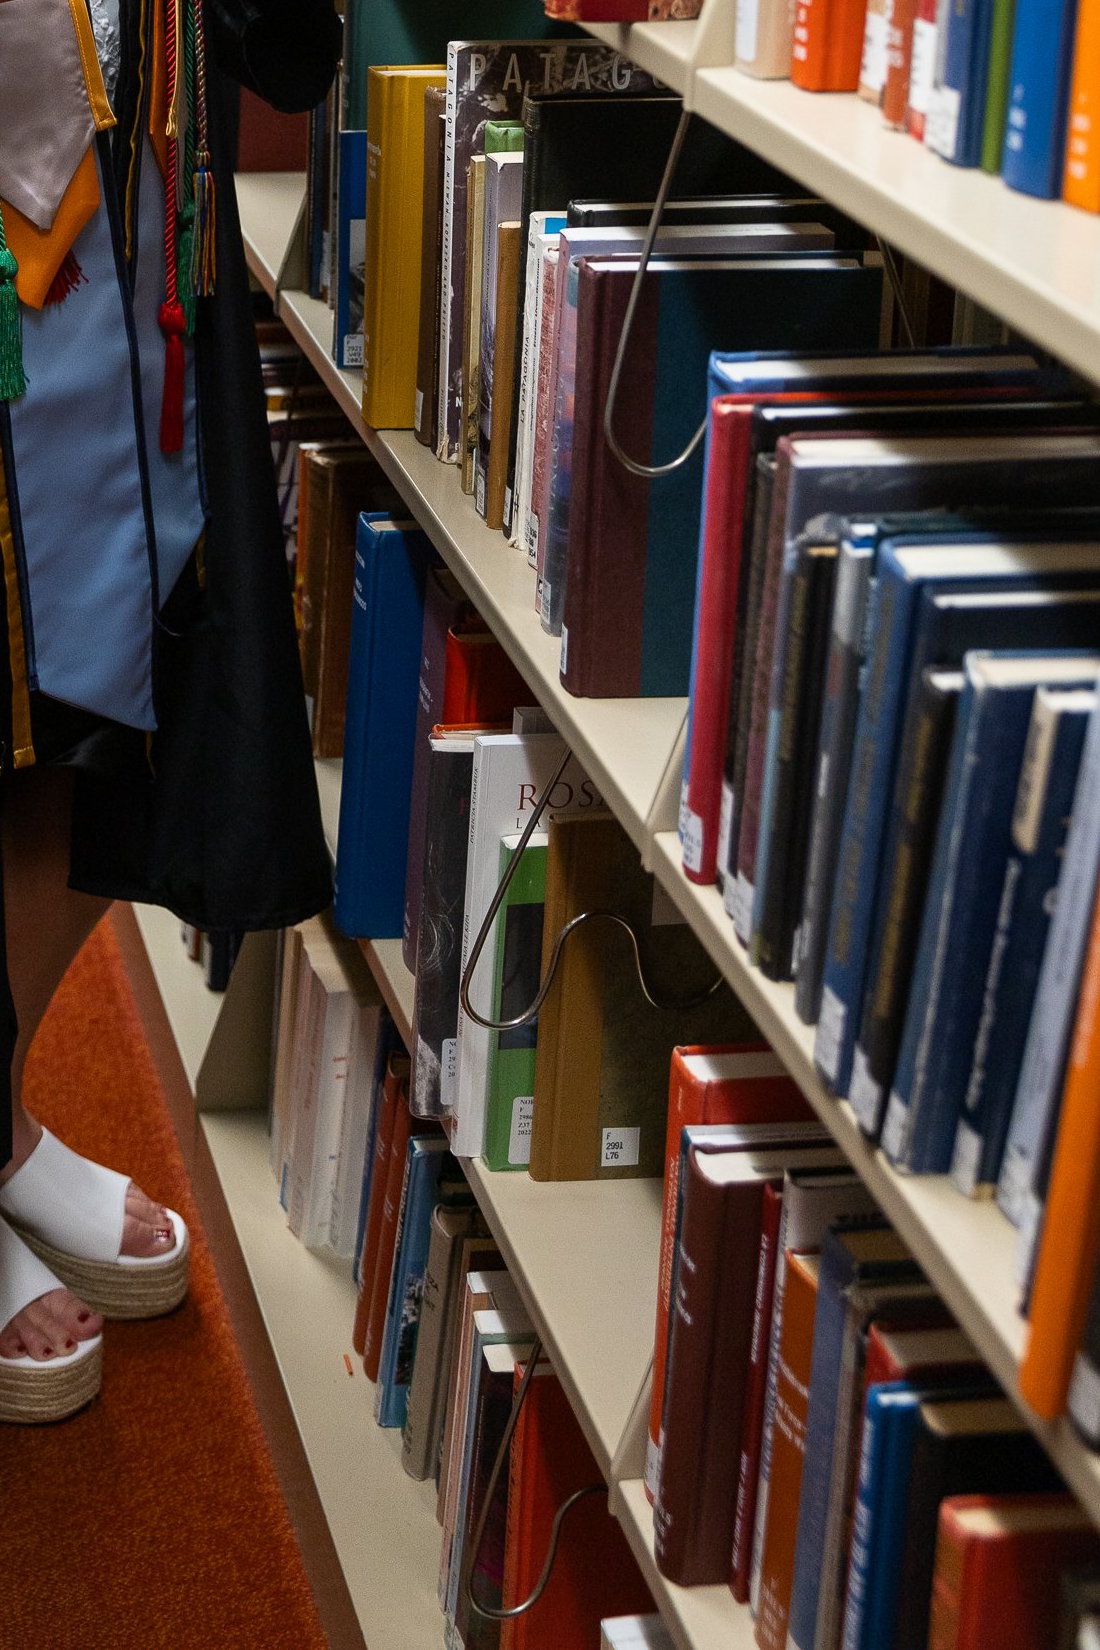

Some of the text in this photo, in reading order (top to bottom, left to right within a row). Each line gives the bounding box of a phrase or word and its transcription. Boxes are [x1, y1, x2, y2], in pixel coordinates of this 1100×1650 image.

[469, 52, 667, 93] PATAG
[446, 52, 454, 161] PATAGONIA
[520, 336, 530, 423] LA PATAGONIA
[606, 1141, 623, 1149] 2991
[607, 1132, 612, 1140] F
[605, 1151, 619, 1160] L76
